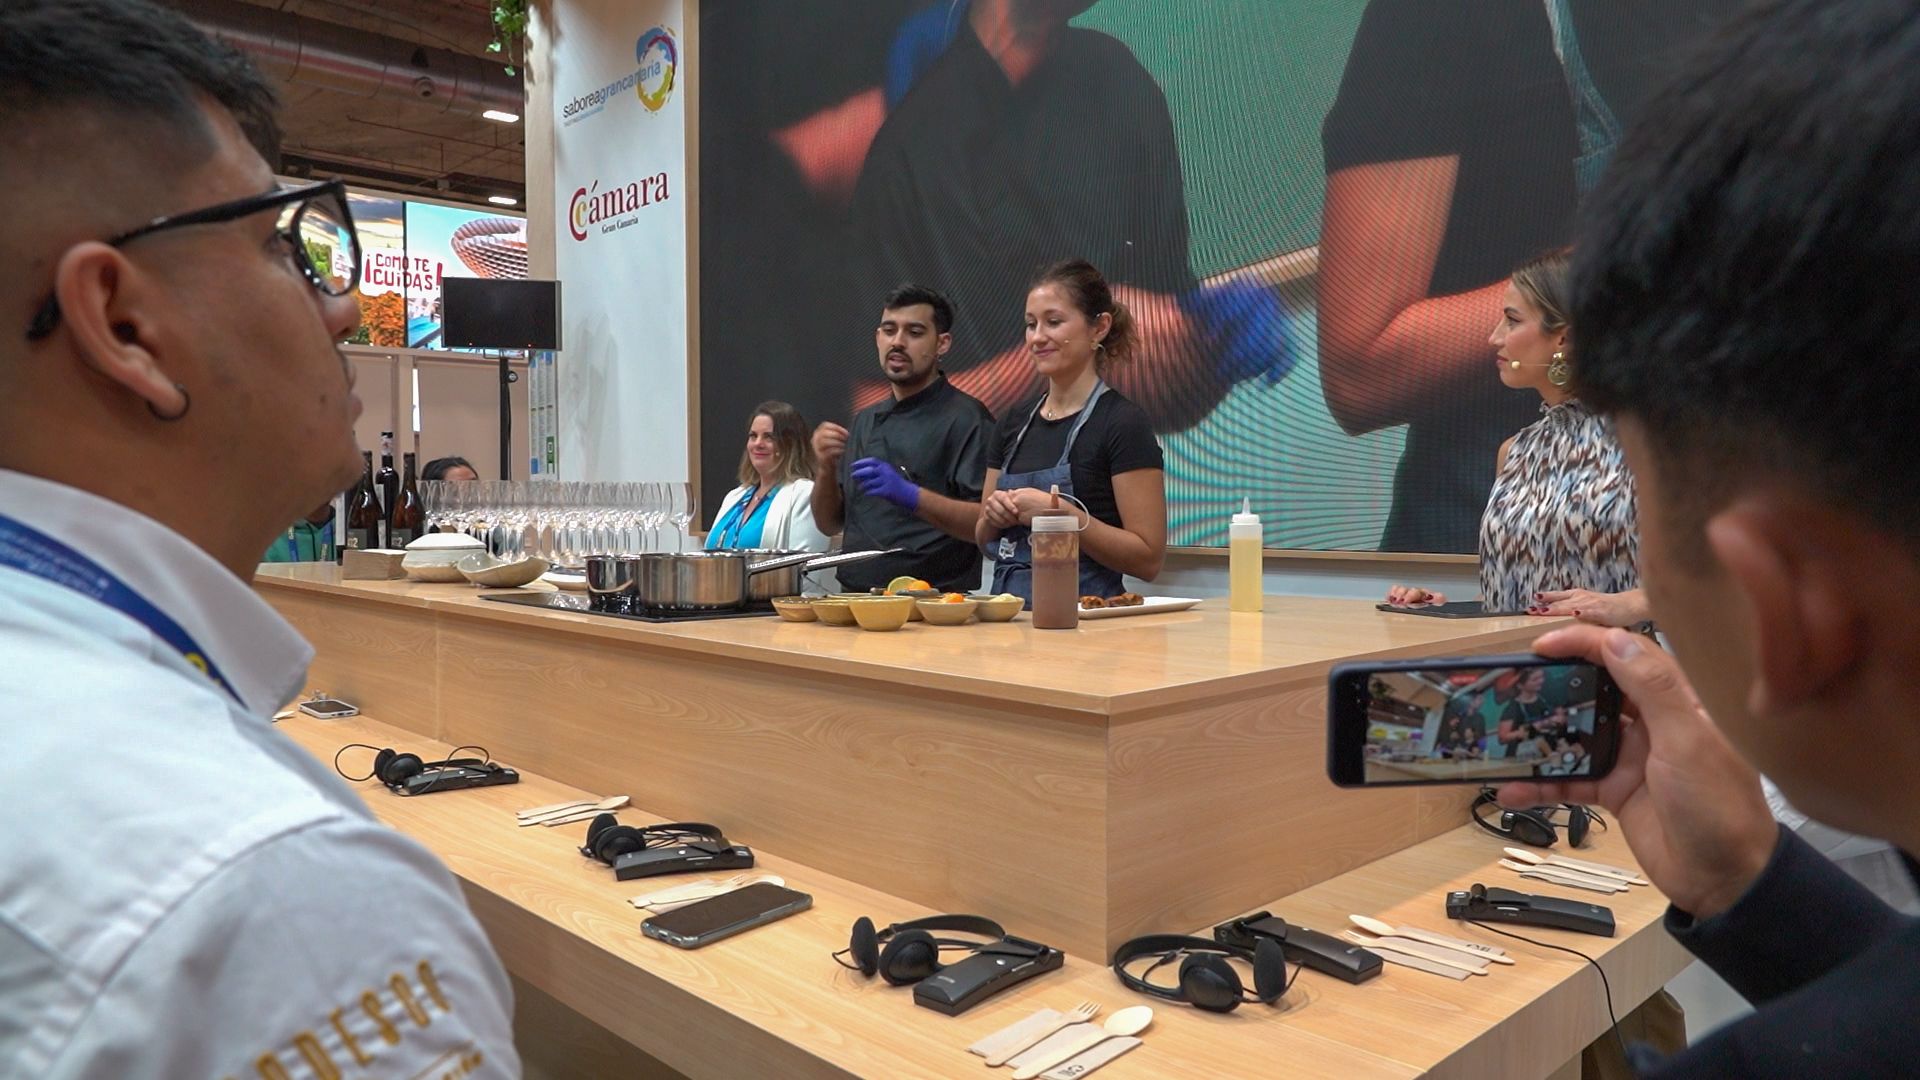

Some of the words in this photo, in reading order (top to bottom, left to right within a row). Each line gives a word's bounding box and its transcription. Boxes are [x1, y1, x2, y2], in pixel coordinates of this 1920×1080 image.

[601, 223, 616, 234] Gran
[616, 215, 639, 230] Canaria
[414, 258, 430, 272] TE
